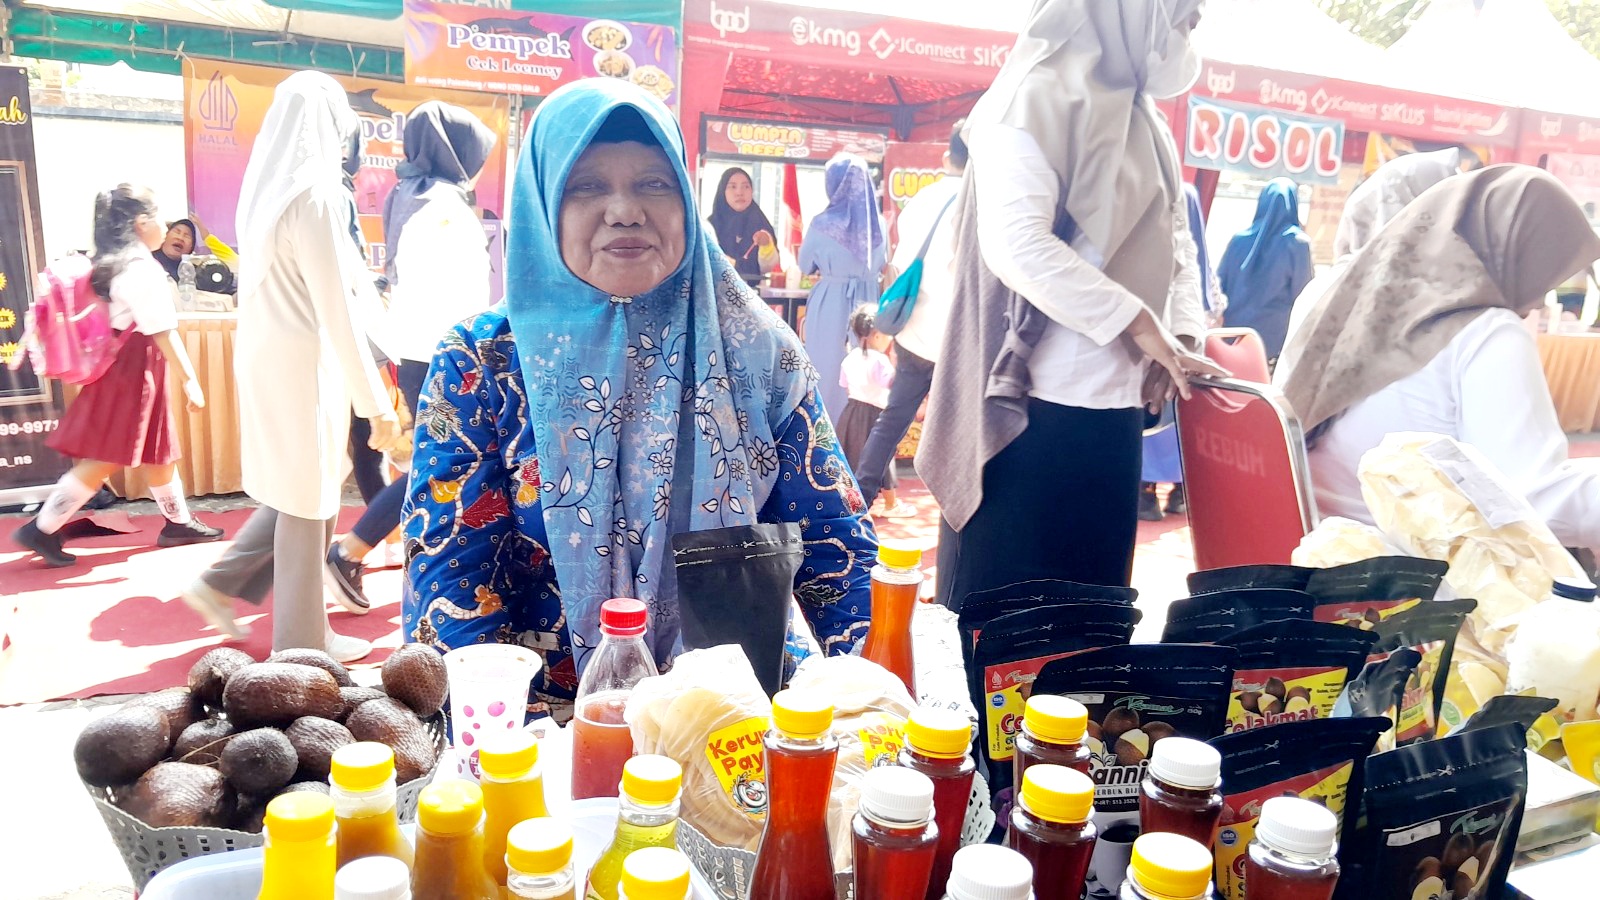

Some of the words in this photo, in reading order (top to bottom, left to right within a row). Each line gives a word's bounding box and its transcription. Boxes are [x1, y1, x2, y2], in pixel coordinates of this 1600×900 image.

[448, 23, 571, 60] Pempek
[973, 44, 1008, 67] SIK
[198, 133, 238, 145] HALAL
[728, 121, 803, 146] LUMPIA
[1189, 104, 1343, 177] RISOL
